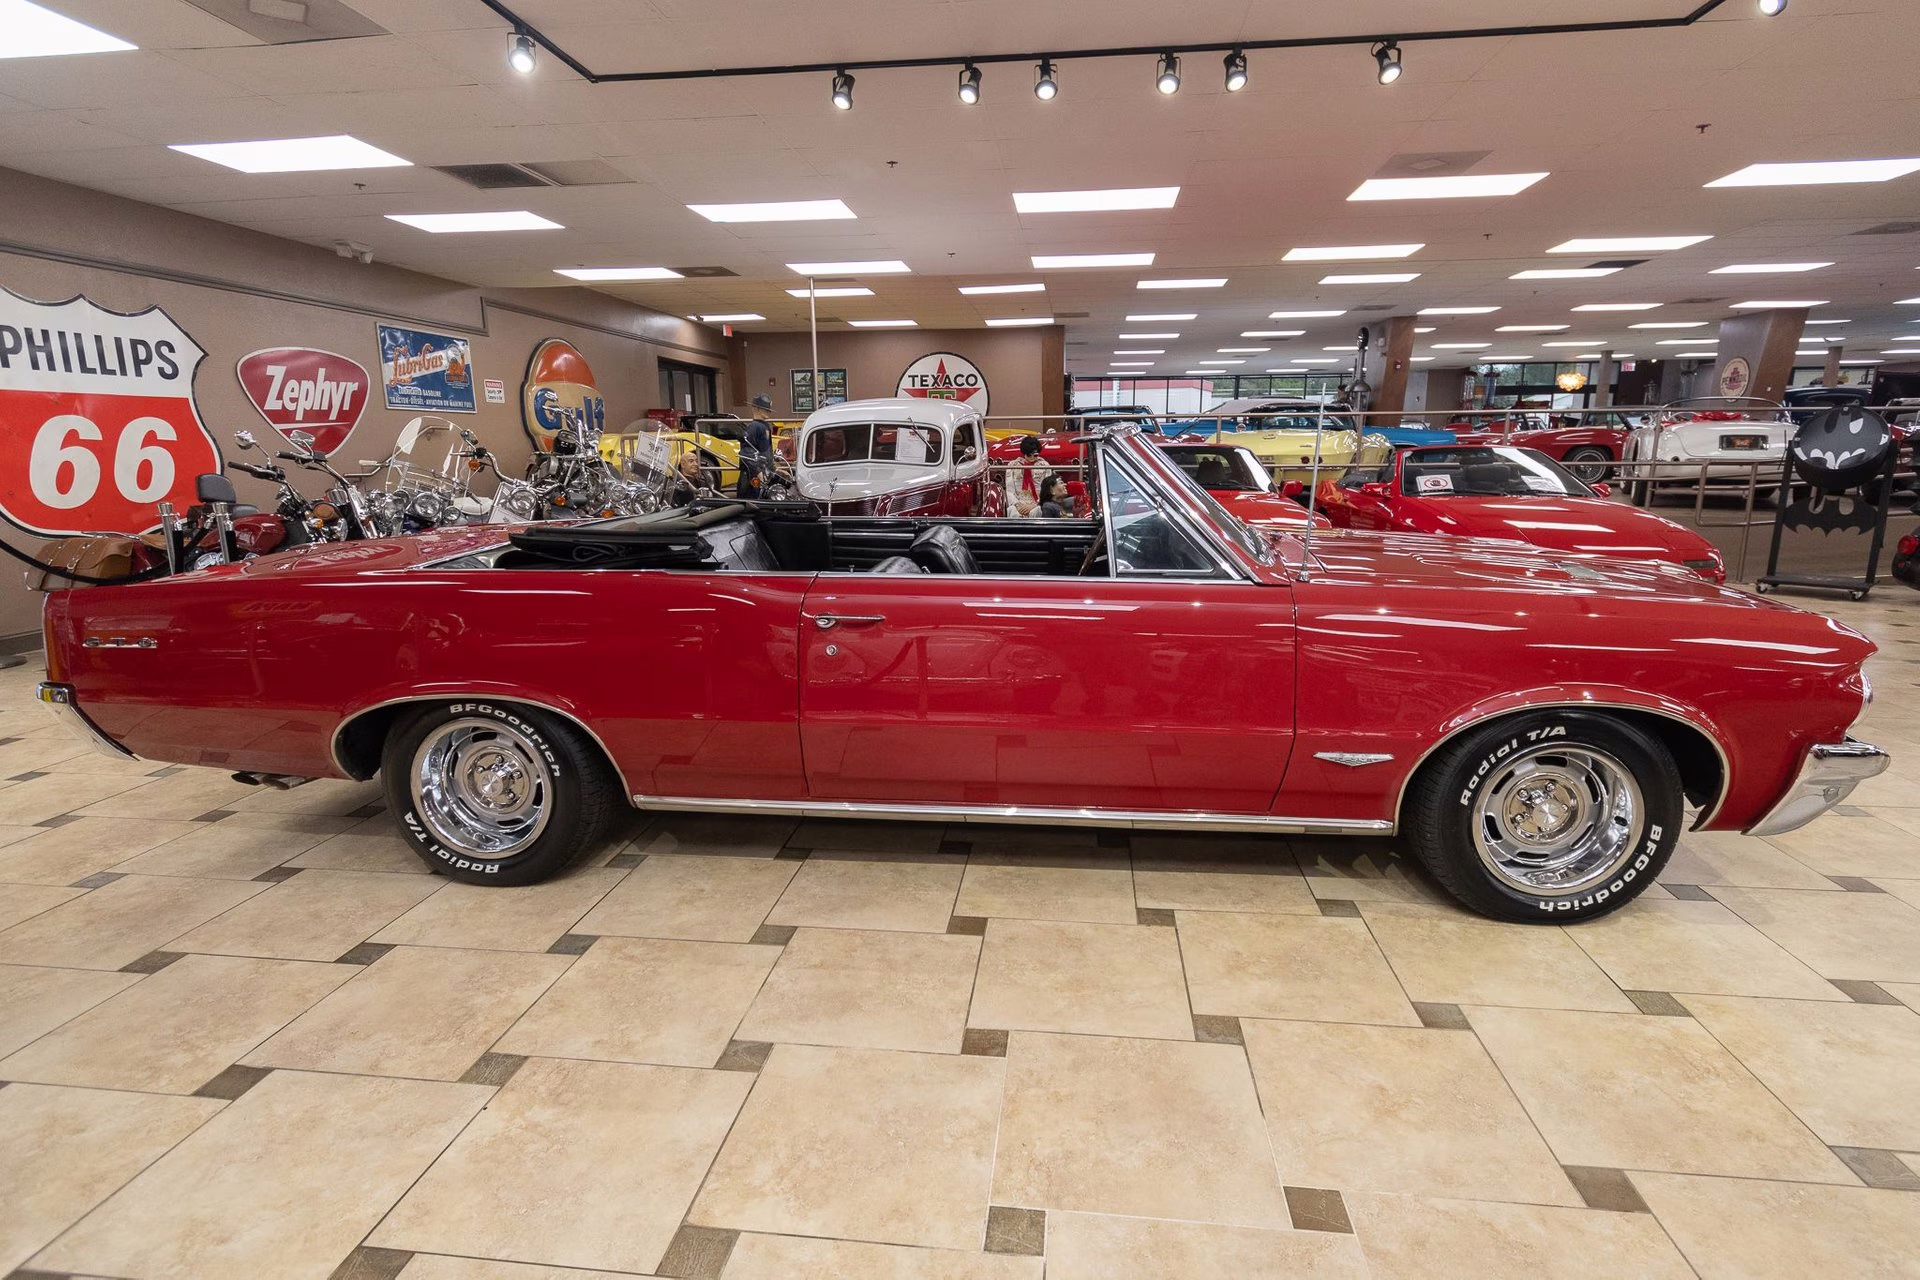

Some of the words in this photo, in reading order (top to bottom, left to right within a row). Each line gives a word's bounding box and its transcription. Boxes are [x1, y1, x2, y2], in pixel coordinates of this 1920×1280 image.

[0, 325, 180, 381] PHILLIPS
[908, 373, 978, 388] TEXACO
[263, 364, 359, 421] Zephyr
[423, 389, 442, 397] GASOLINE
[29, 414, 178, 510] 66
[450, 703, 561, 777] BFGoodrich
[1460, 738, 1518, 806] Radial
[1527, 726, 1566, 741] T/A
[404, 811, 427, 843] T/A
[428, 844, 499, 874] Radial
[1539, 824, 1663, 911] BFGoodrich
